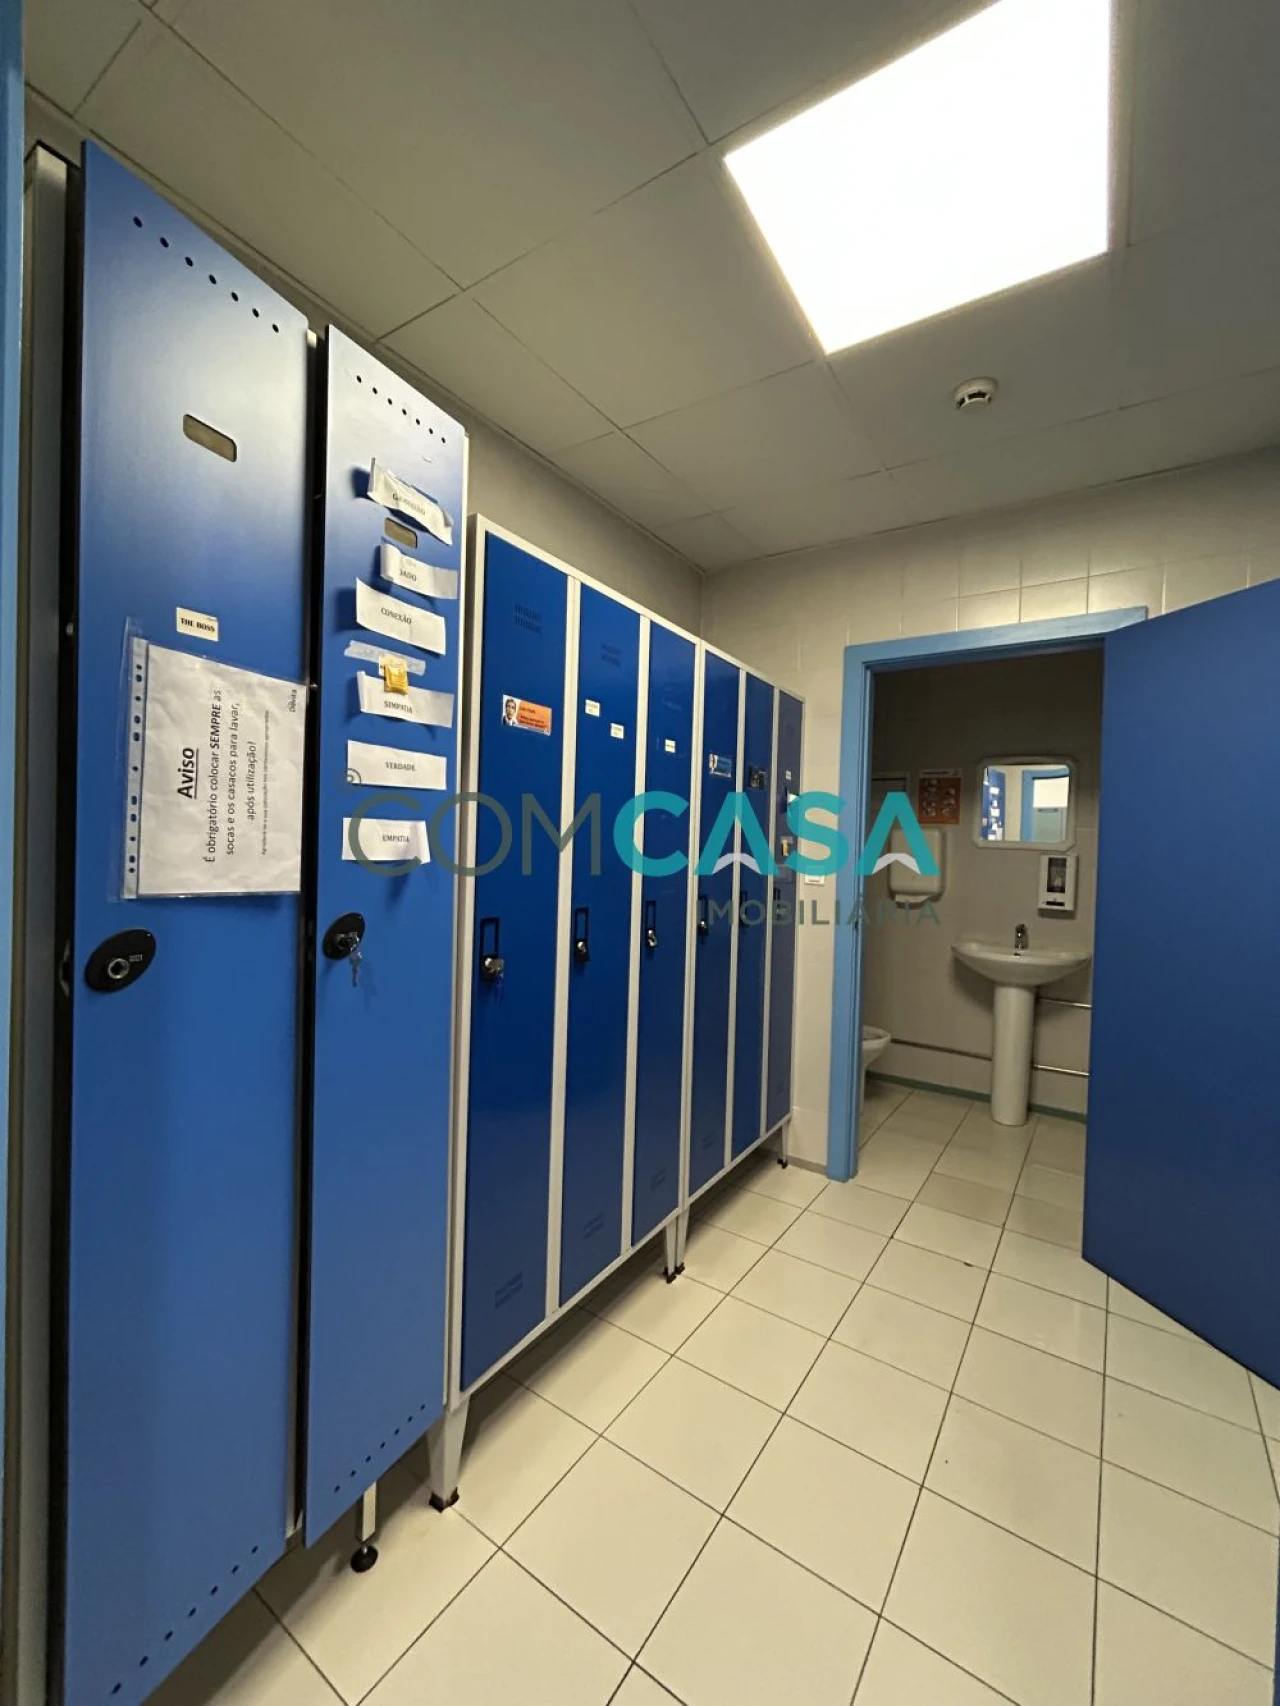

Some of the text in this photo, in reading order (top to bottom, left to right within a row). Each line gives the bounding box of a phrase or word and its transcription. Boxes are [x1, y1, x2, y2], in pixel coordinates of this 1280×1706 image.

[181, 617, 216, 632] THE BOSS
[380, 607, 412, 625] CONEXÃO
[228, 703, 240, 731] lavar,
[383, 700, 413, 714] SIMPATIA
[228, 734, 239, 757] para
[176, 747, 196, 800] Aviso
[203, 690, 221, 863] É obrigatório colocar SEMPRE as
[227, 759, 237, 800] casacos
[245, 741, 257, 821] após utilização!
[227, 803, 235, 815] os
[225, 826, 235, 855] socas
[382, 835, 410, 843] EMPATIA
